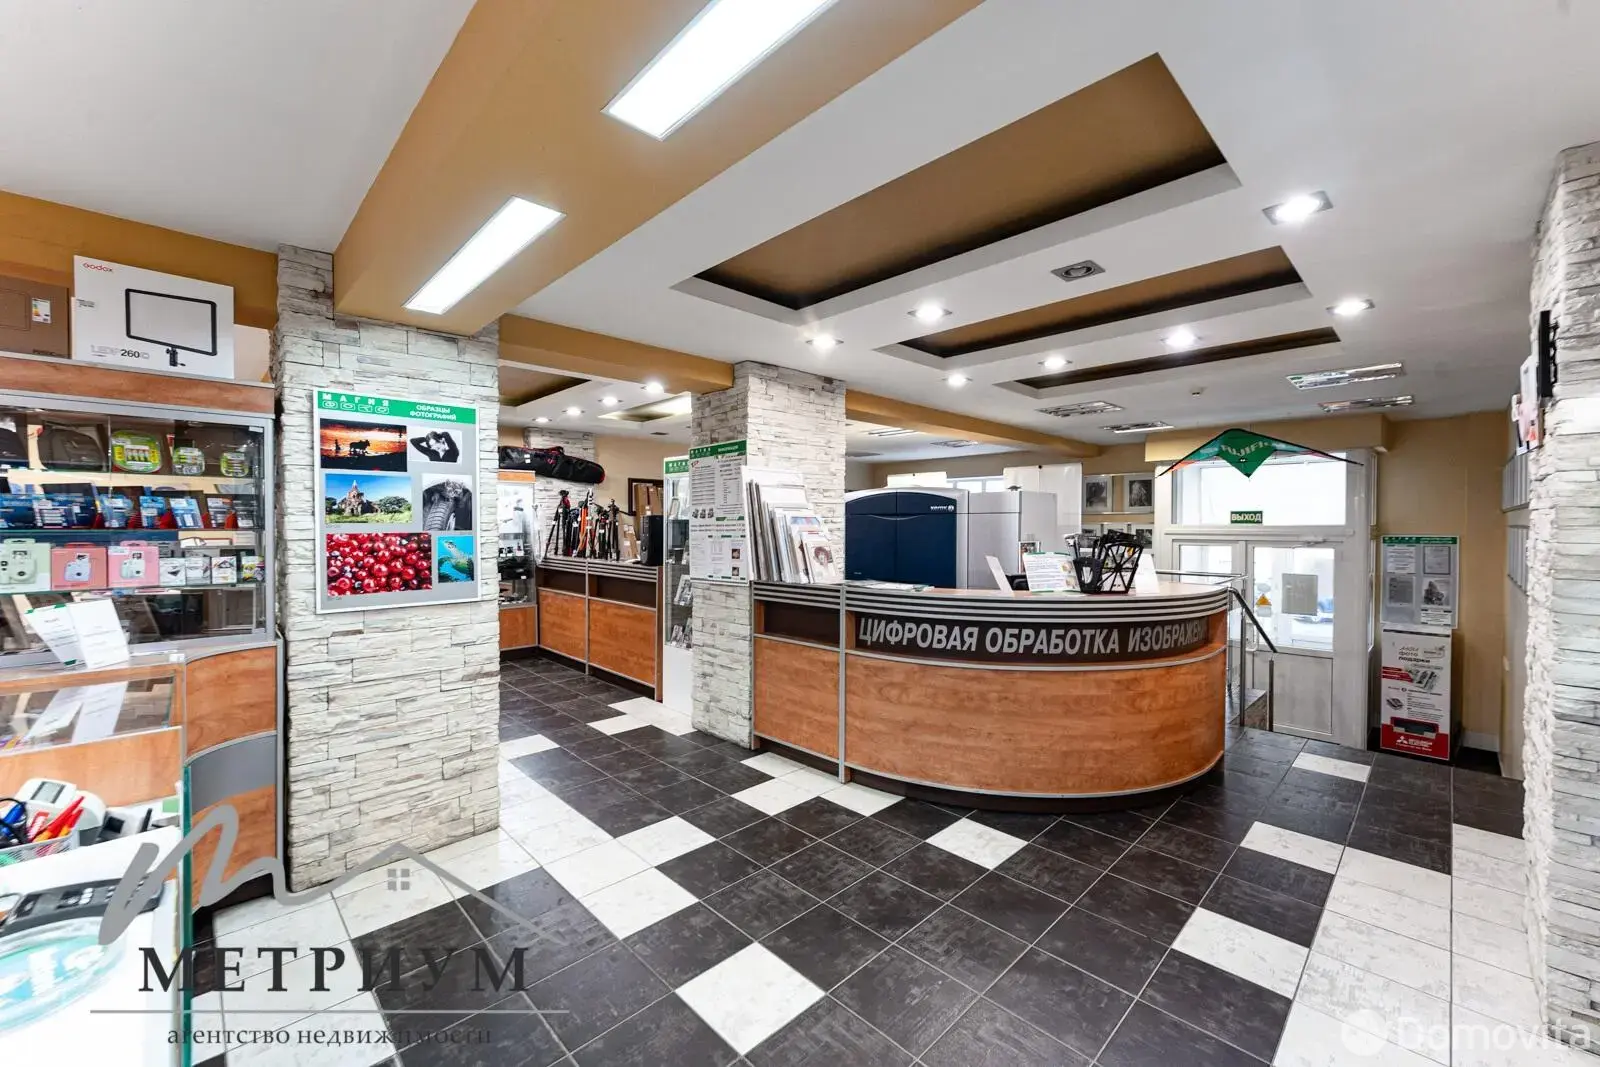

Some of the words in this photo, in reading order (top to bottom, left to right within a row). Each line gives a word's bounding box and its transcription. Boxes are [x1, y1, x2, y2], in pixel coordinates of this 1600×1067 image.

[322, 393, 389, 406] МАГИЯ
[416, 404, 450, 413] ОБРАЗЦЫ
[1231, 513, 1262, 522] ВЫХОД
[859, 617, 979, 652] ЦИФРОВАЯ
[985, 627, 1120, 655] ОБРАБОТКА
